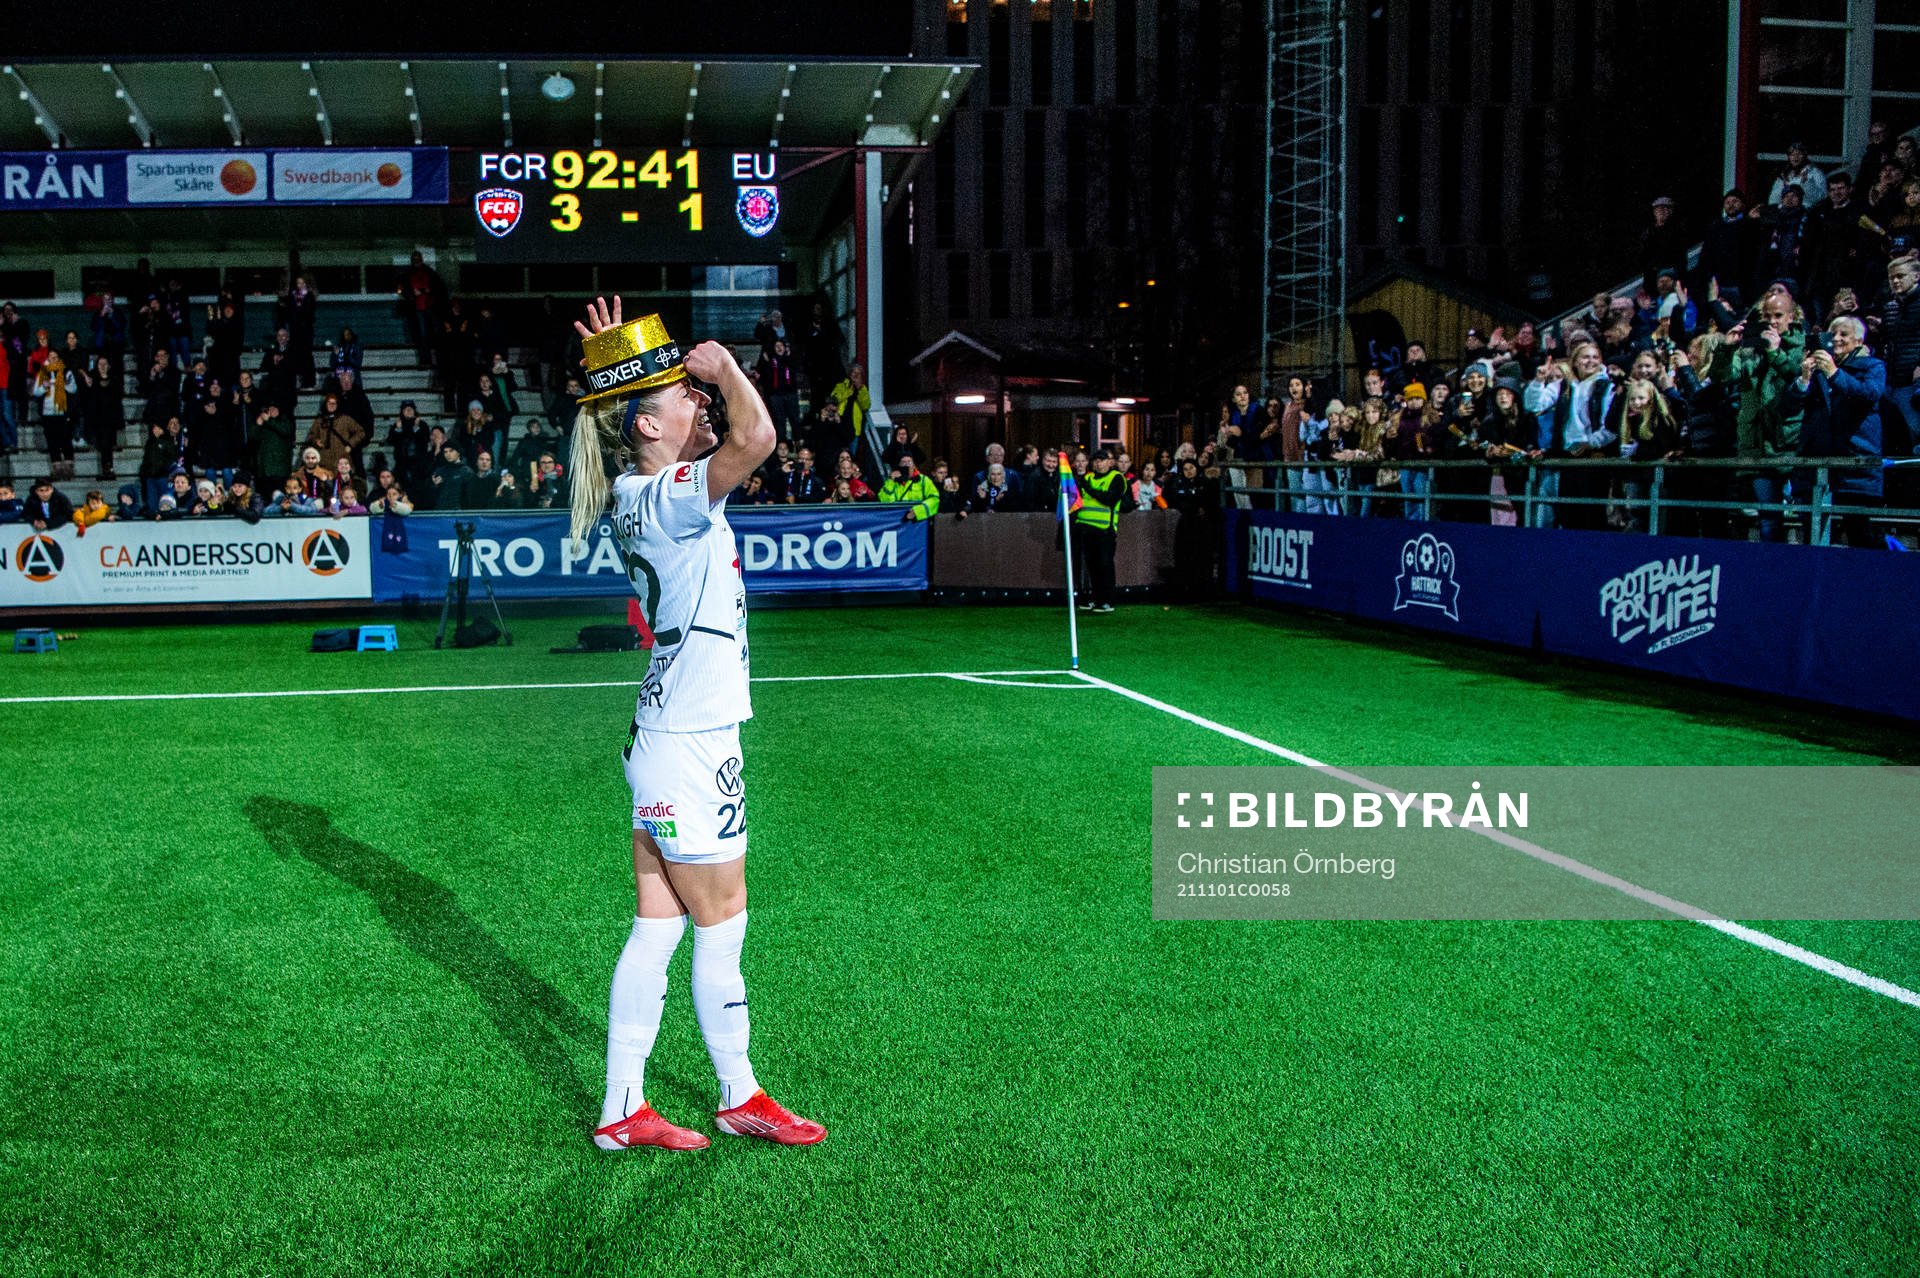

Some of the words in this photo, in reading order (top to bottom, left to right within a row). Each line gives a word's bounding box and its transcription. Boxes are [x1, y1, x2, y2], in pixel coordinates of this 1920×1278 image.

[4, 153, 104, 199] RÅN
[137, 163, 214, 178] Sparbanken
[174, 178, 214, 191] Skåne
[284, 168, 372, 185] Swedbank
[480, 153, 547, 180] FCR
[551, 150, 699, 189] 92:41
[733, 153, 776, 179] EU
[482, 201, 516, 214] FCR
[550, 193, 583, 232] 3
[678, 193, 703, 231] 1
[439, 537, 545, 577] TRO
[560, 525, 626, 576] PÅ
[744, 521, 898, 571] DRÖM
[1248, 525, 1314, 580] BOOST
[1600, 554, 1711, 617] FOOTBALL
[1612, 593, 1650, 638] FOR
[1649, 564, 1721, 635] LIFE!
[637, 801, 675, 817] andic
